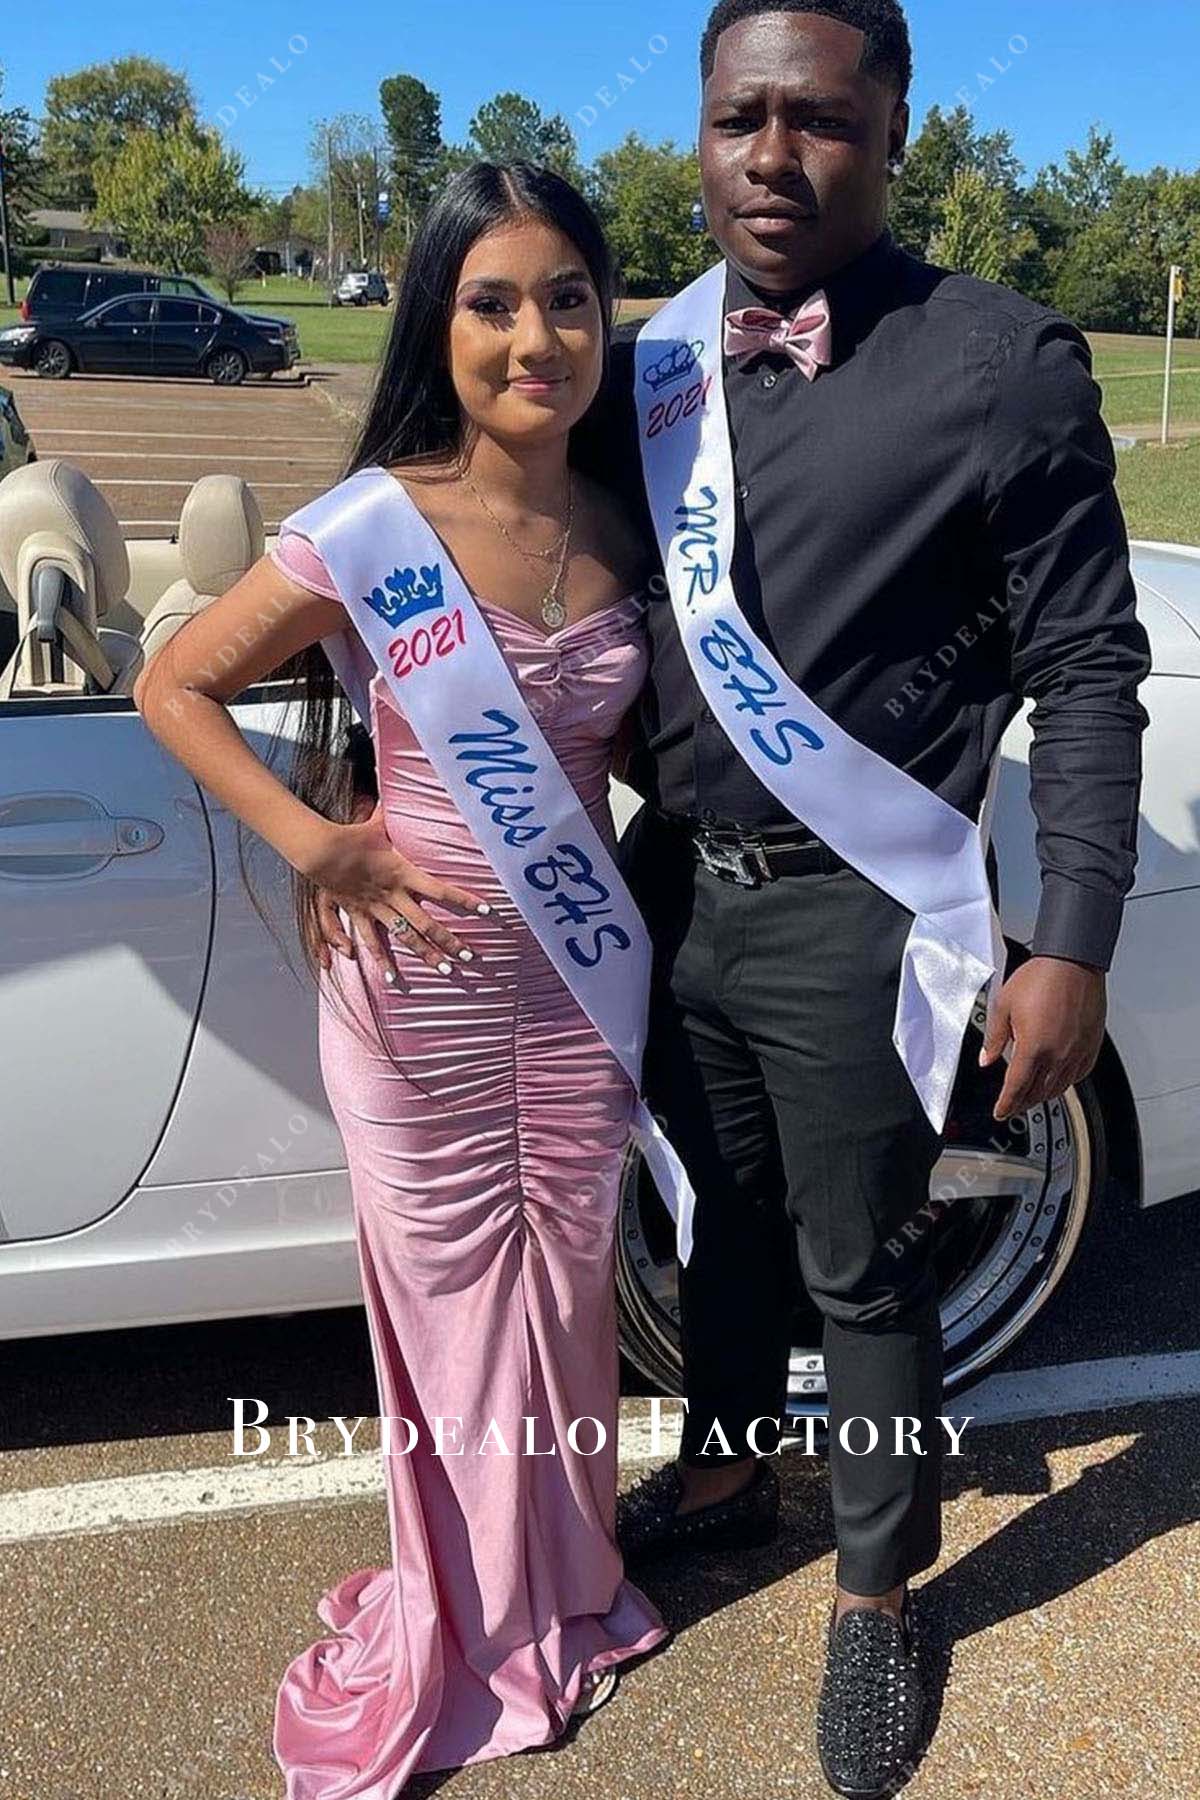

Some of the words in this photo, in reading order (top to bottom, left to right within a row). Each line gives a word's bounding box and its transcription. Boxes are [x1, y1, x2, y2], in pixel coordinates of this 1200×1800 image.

[646, 375, 712, 438] 2021
[388, 608, 466, 678] 2021
[700, 619, 825, 765] BHS
[448, 709, 547, 848] Miss
[523, 843, 632, 968] BHS
